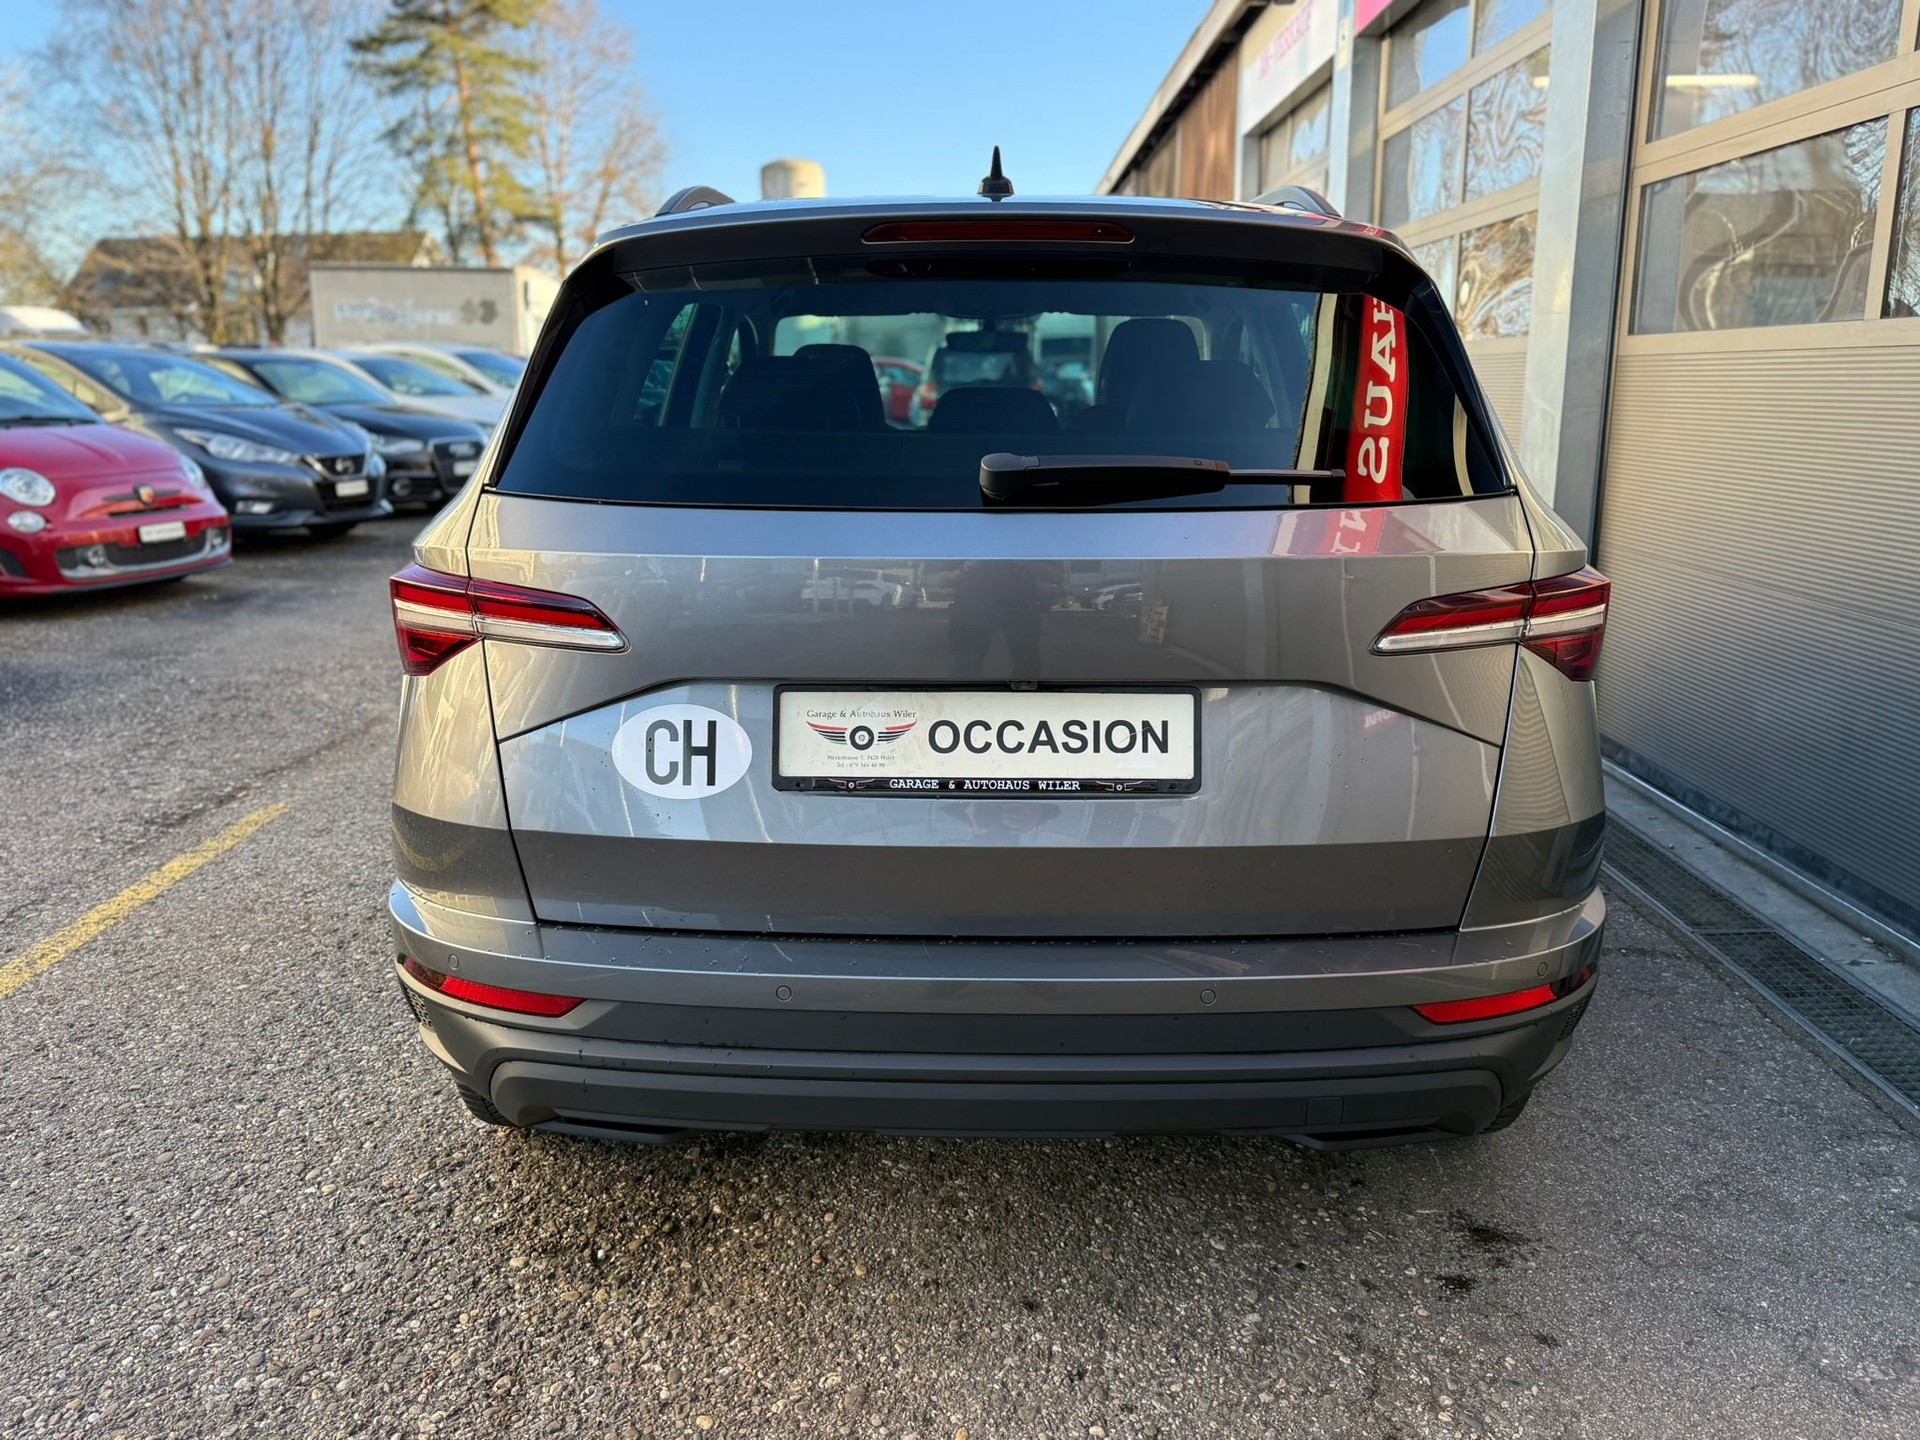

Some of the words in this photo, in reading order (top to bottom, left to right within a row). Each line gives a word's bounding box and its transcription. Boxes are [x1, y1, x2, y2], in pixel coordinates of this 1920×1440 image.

[806, 709, 837, 720] Garage
[839, 709, 847, 718] &
[849, 709, 891, 718] Autohaus
[893, 709, 917, 718] Wiler
[928, 719, 1169, 754] OCCASION
[645, 719, 717, 786] CH
[889, 779, 939, 790] GARAGE
[948, 779, 956, 790] &
[963, 779, 1031, 790] AUTOHAUS
[1037, 779, 1081, 790] WILER
